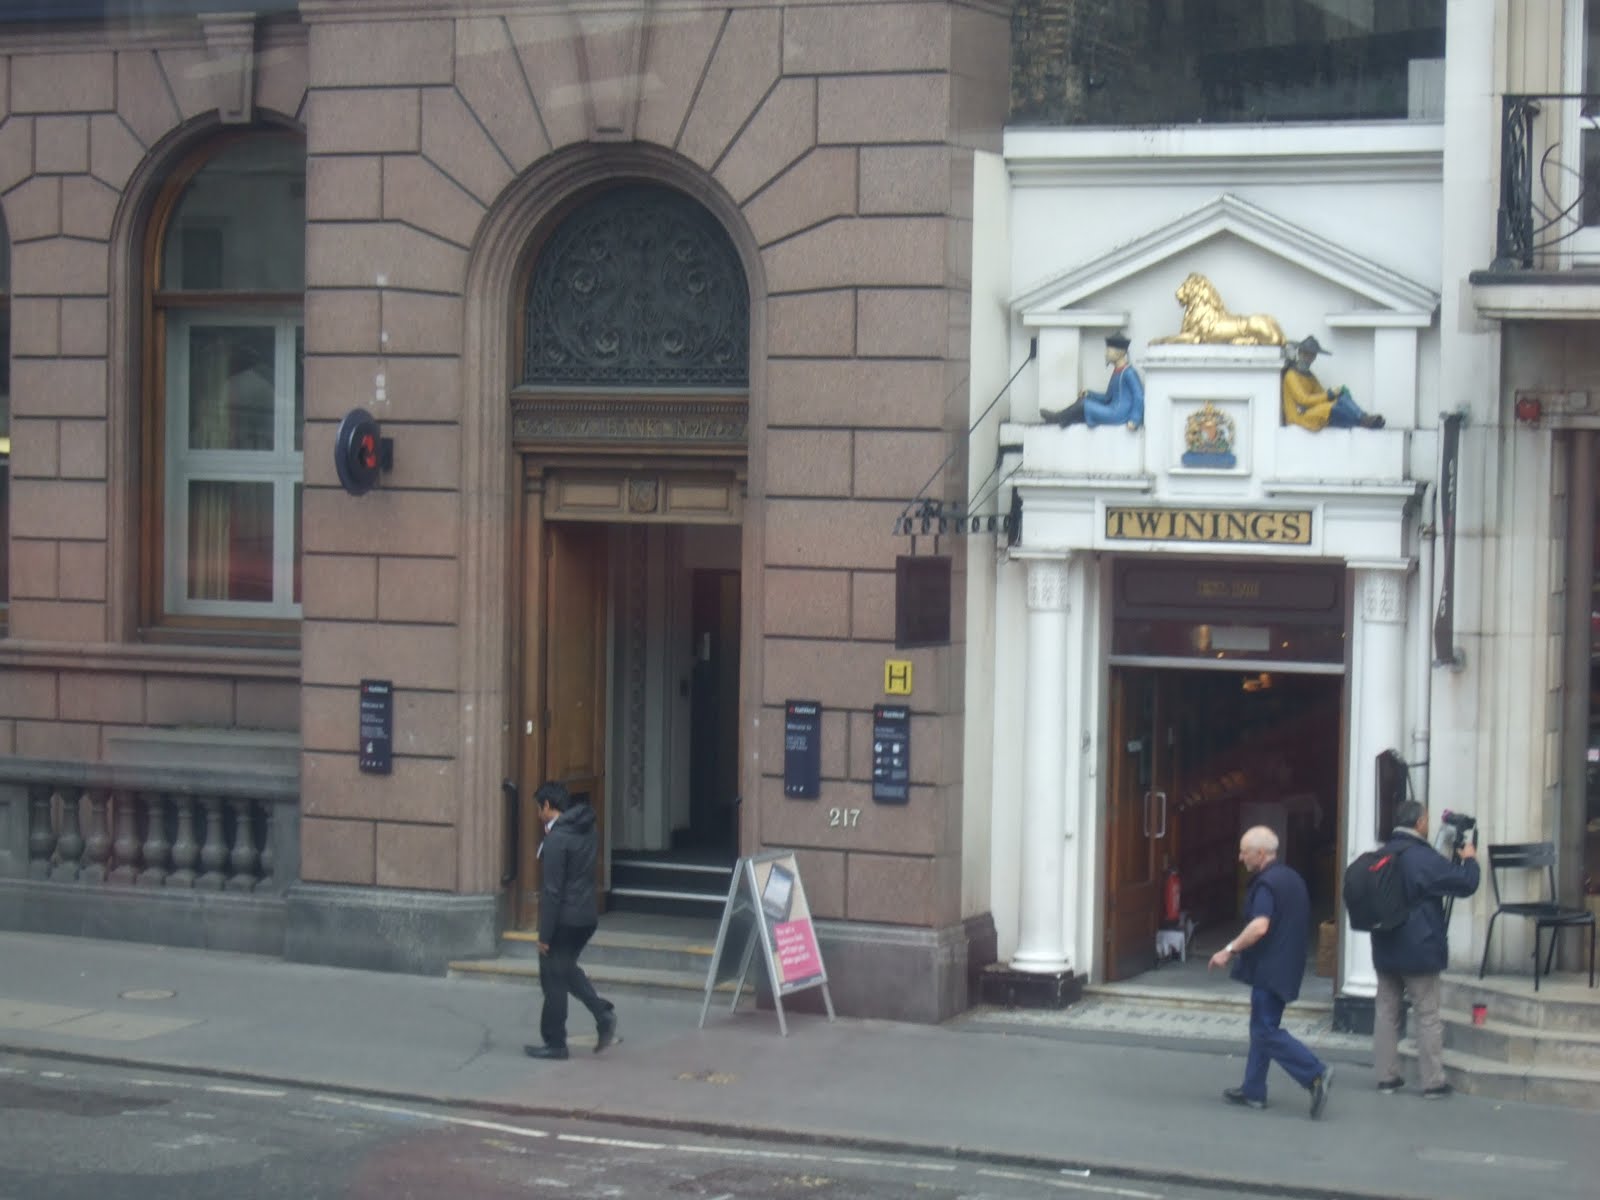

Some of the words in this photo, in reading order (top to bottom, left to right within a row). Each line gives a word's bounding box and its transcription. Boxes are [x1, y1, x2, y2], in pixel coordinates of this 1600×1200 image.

[1109, 511, 1301, 539] TWININGS
[888, 664, 908, 691] H
[829, 807, 861, 828] 217
